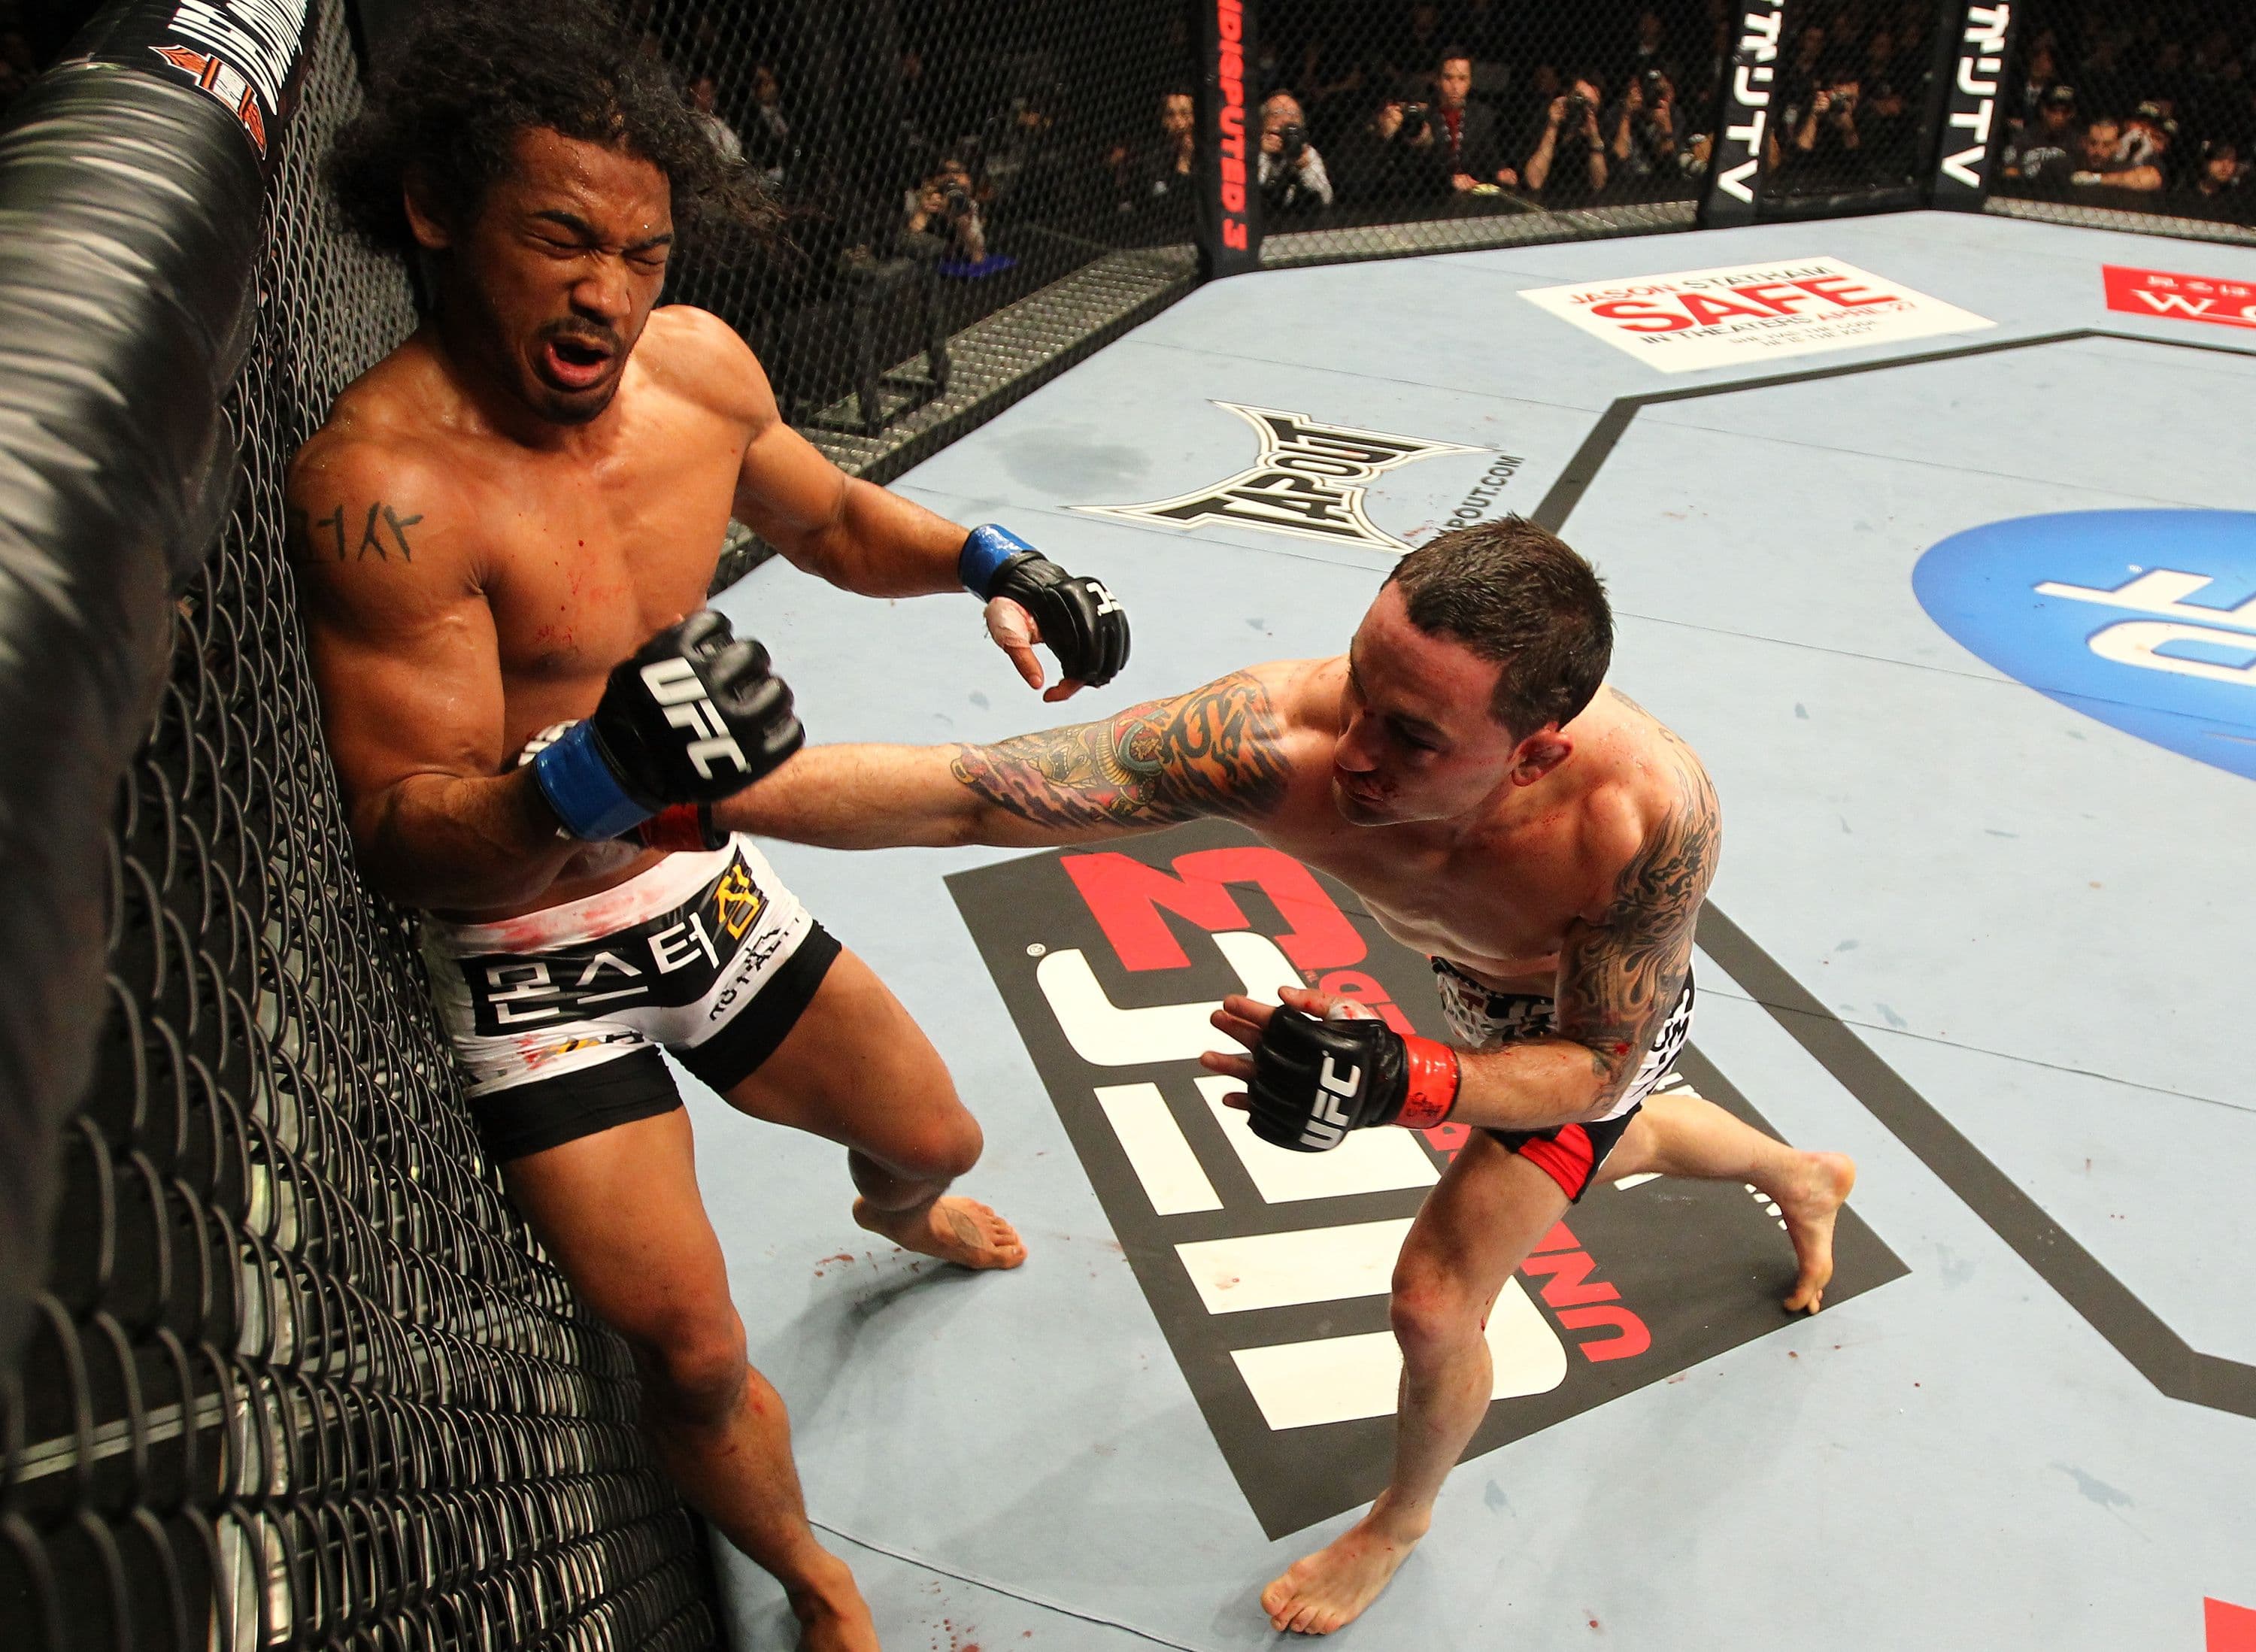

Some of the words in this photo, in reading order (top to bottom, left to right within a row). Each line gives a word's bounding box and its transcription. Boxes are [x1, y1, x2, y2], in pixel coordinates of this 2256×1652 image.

[1222, 218, 1248, 251] 3
[1569, 283, 1678, 304] JASON
[1682, 266, 1835, 289] STATHAM
[1590, 275, 1901, 332] SAFE
[1639, 333, 1672, 344] IN
[1672, 314, 1812, 338] THEATERS
[1816, 305, 1885, 320] APRIL
[1442, 454, 1526, 529] POUT.COM
[640, 656, 747, 780] UFC
[1060, 847, 1367, 971] 3
[1298, 1056, 1362, 1150] UFC
[1036, 931, 1567, 1431] UFC
